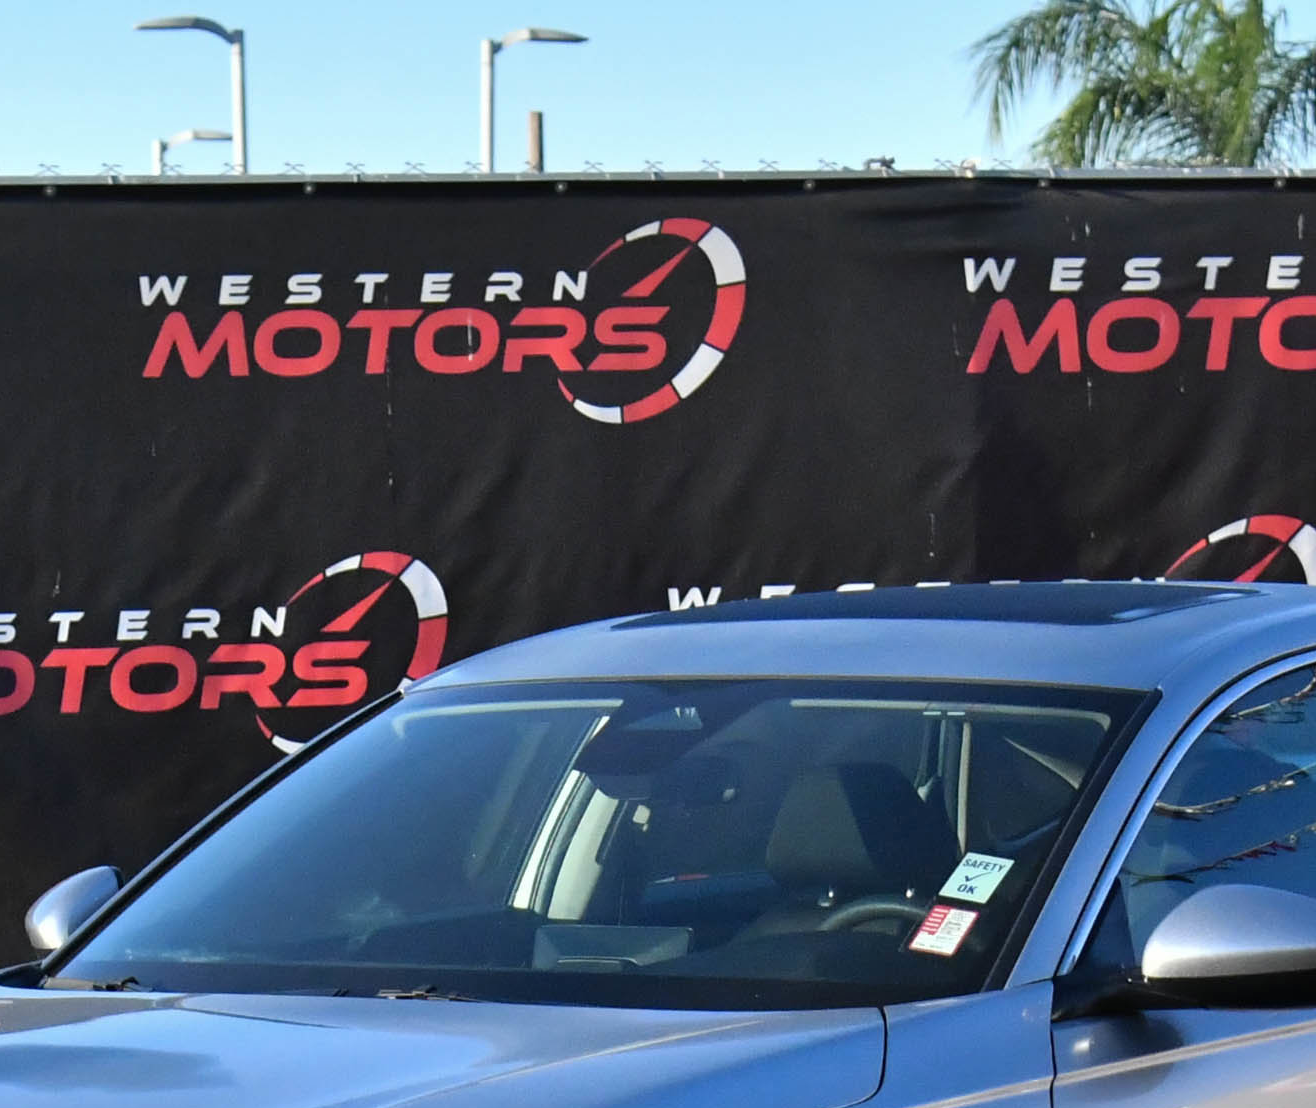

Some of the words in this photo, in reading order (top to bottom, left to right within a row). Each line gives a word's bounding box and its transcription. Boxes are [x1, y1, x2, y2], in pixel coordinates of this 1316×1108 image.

[140, 270, 588, 307] WESTERN
[142, 305, 670, 379] MOTORS
[963, 858, 1006, 873] SAFETY
[956, 883, 978, 895] OK
